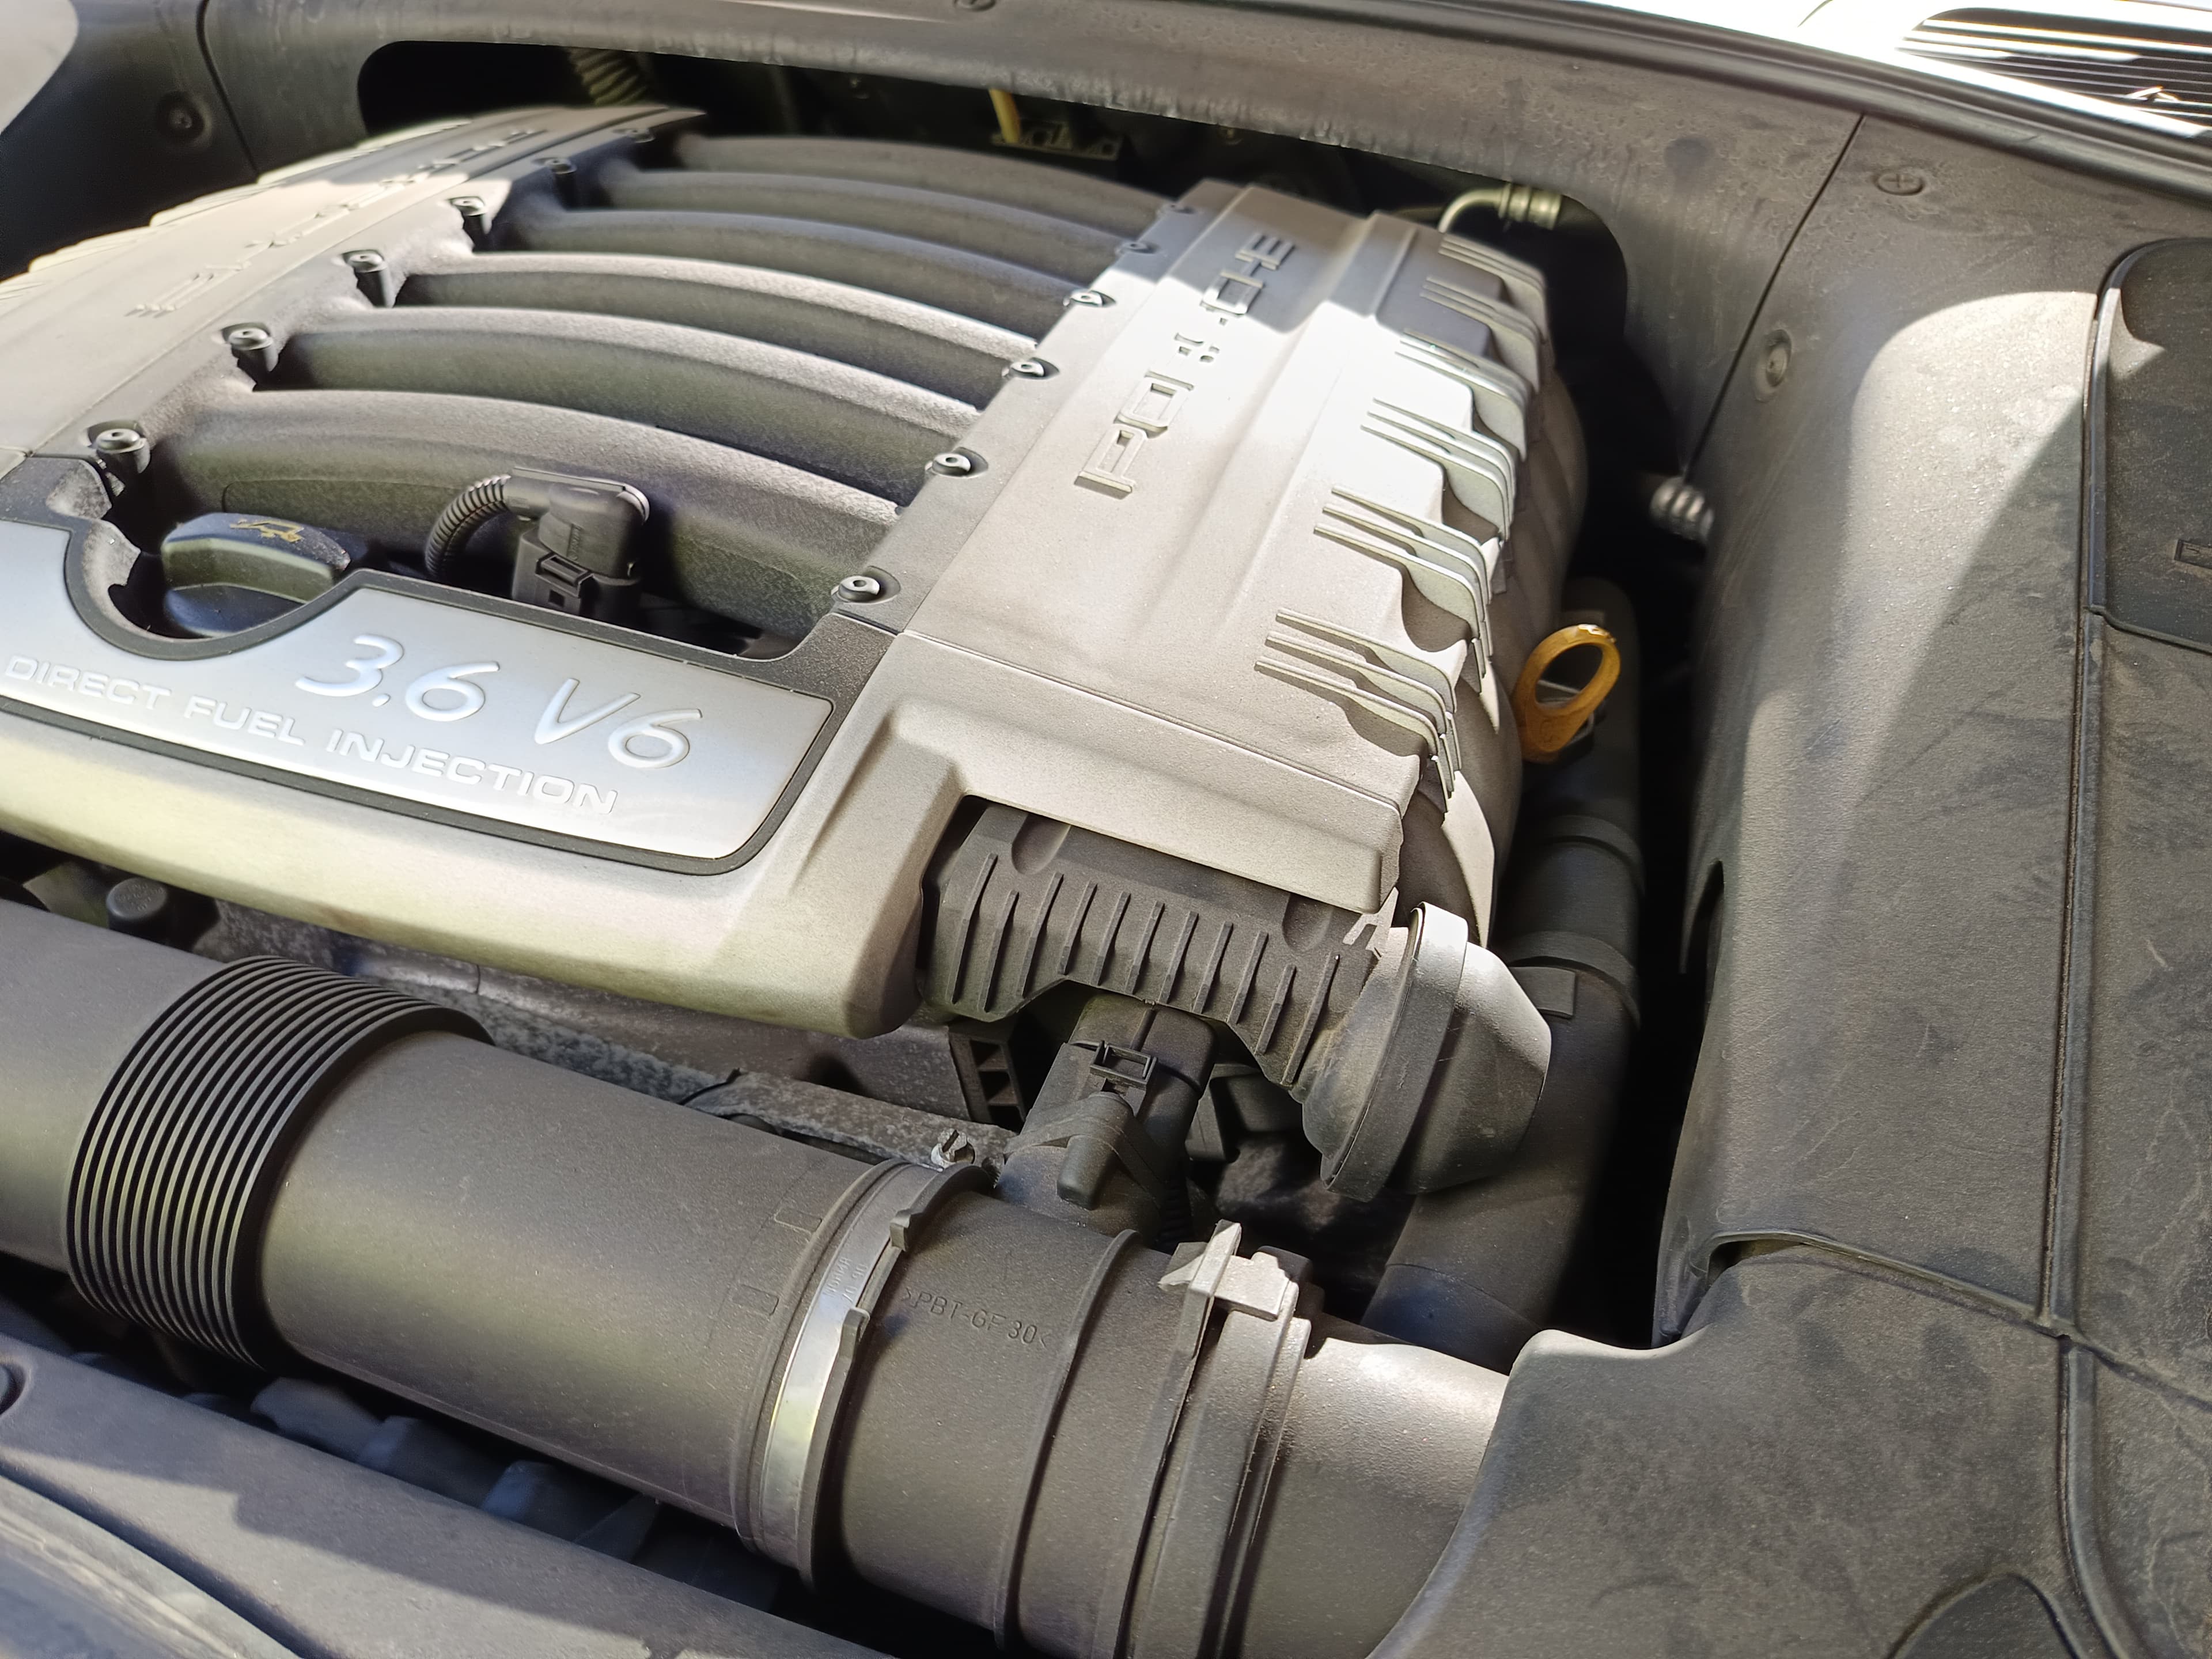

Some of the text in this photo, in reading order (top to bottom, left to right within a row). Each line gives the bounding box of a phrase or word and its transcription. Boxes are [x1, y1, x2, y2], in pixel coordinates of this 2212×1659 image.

[3, 654, 619, 816] DIRECT FUEL INJECTION
[294, 633, 703, 768] 3.6 V6
